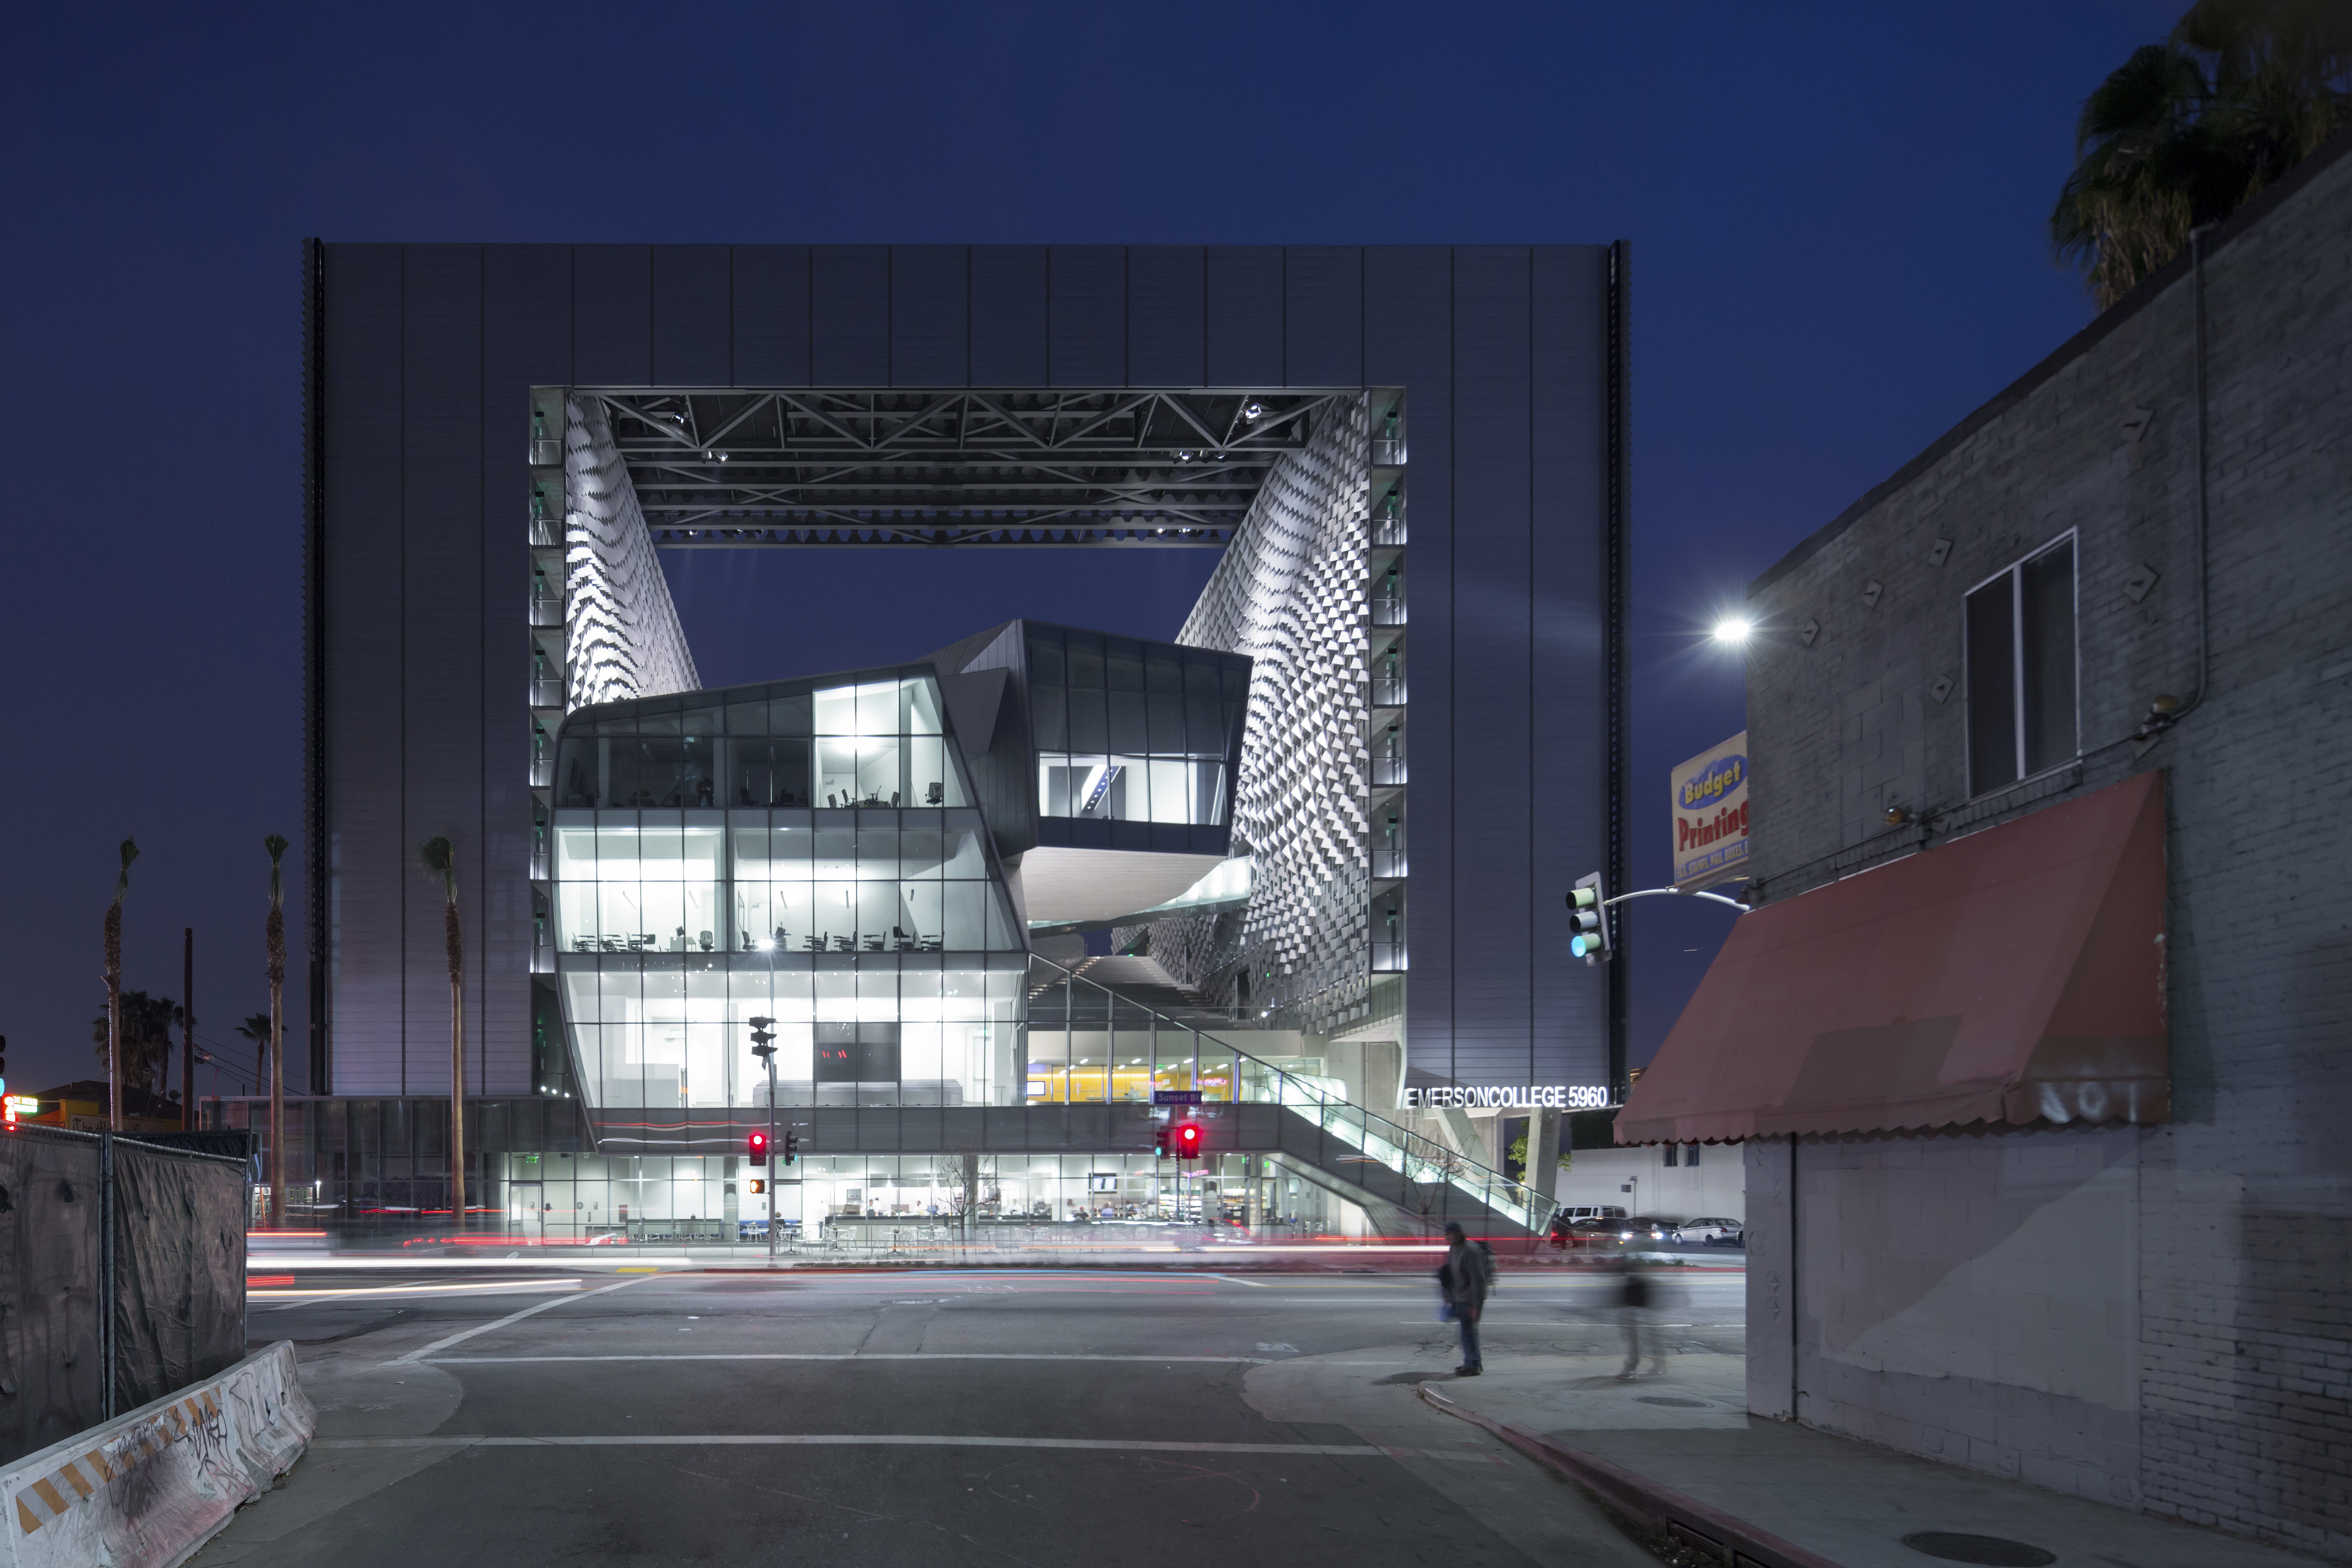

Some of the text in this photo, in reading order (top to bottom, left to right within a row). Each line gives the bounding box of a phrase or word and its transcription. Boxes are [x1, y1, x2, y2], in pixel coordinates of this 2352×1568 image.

[1685, 760, 1741, 805] Budget
[1678, 799, 1749, 852] Printing
[1158, 1093, 1199, 1102] Sunset Bl
[1568, 1086, 1609, 1108] 5960
